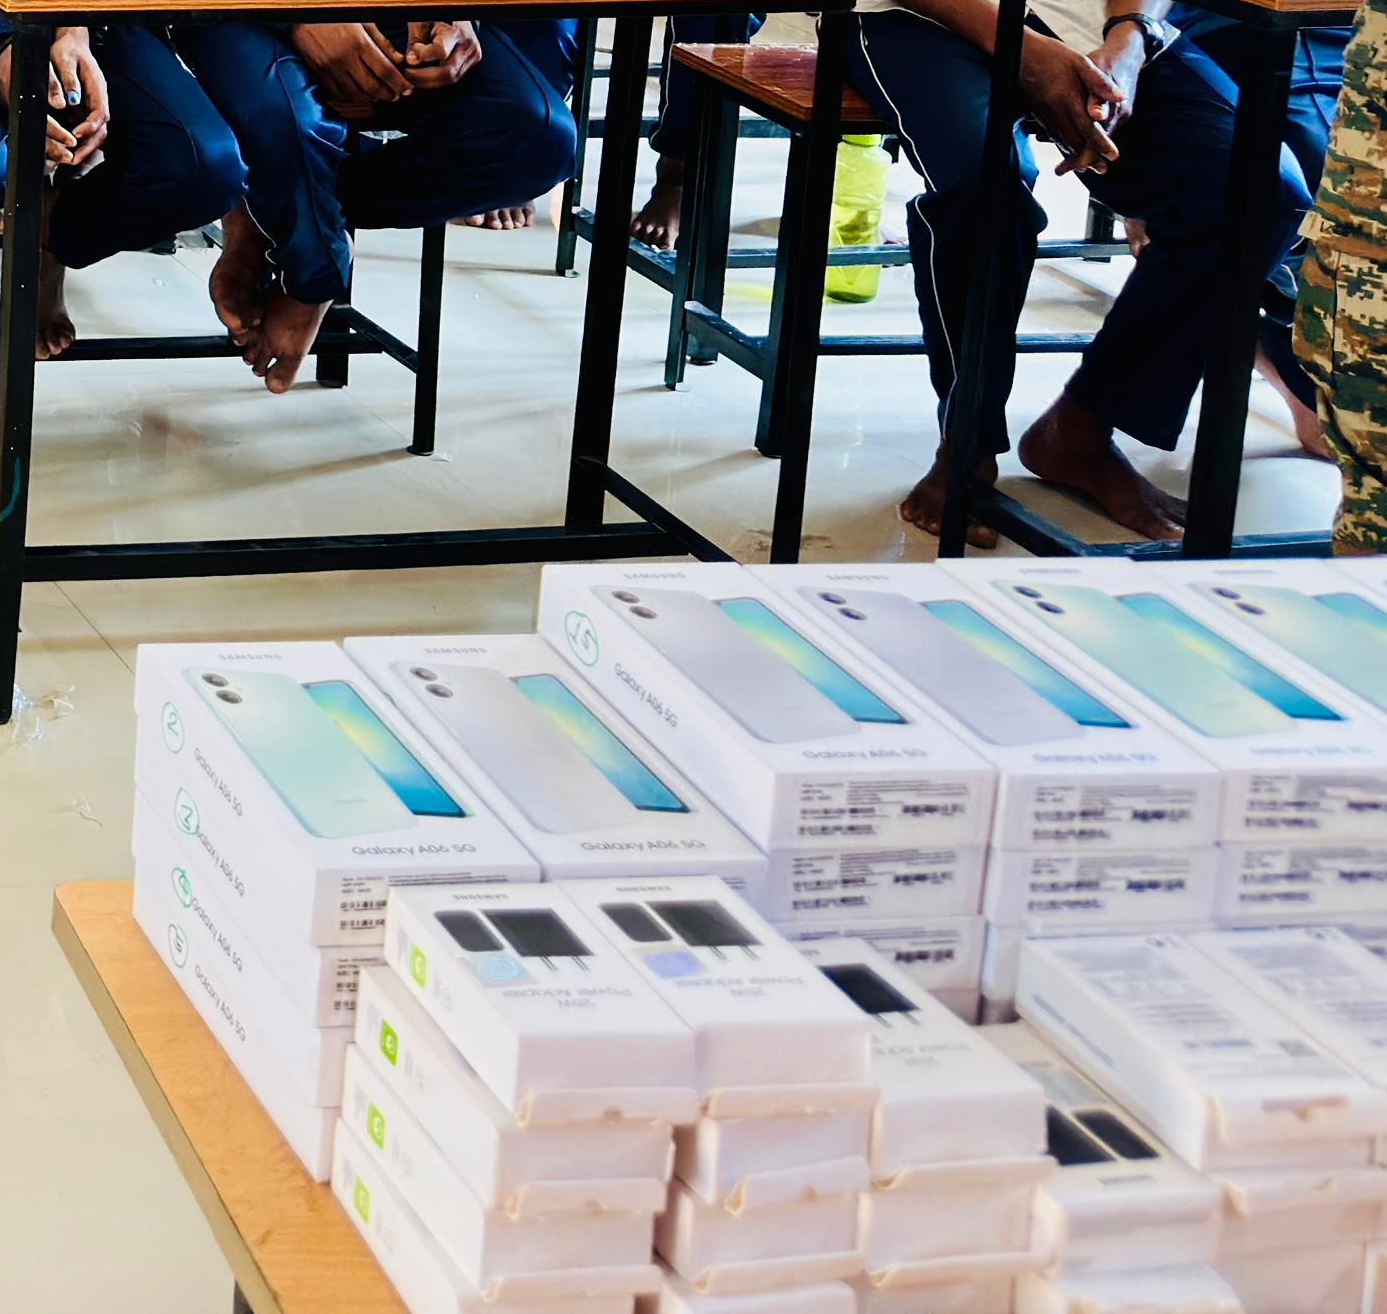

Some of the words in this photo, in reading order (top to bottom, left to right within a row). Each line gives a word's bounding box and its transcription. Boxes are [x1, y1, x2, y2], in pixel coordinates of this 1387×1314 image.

[424, 647, 487, 655] SAMSUNG
[219, 653, 282, 661] SAMSUNG
[351, 844, 415, 856] Galaxy
[580, 841, 643, 852] Galaxy
